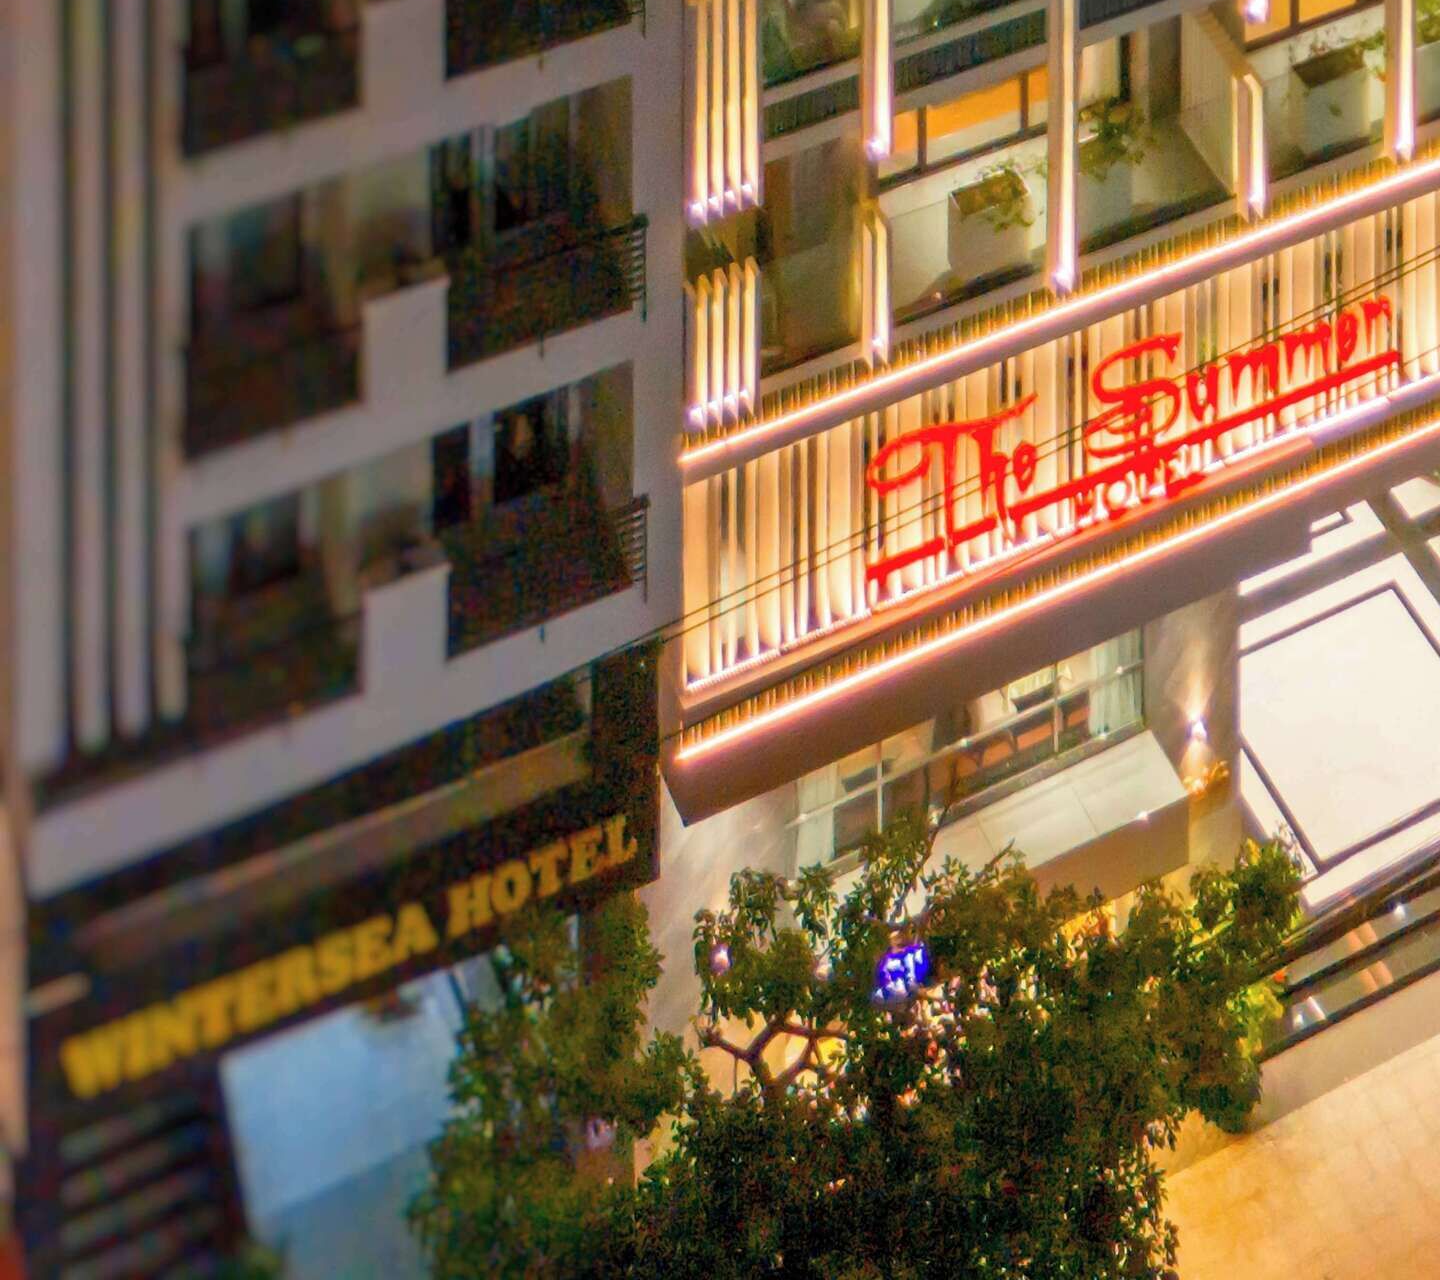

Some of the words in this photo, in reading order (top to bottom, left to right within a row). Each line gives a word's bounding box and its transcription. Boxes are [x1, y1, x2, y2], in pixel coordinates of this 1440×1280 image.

[867, 392, 1039, 550] The
[1084, 295, 1393, 461] Summer
[60, 901, 440, 1099] WINTERSEA
[446, 815, 638, 939] HOTEL
